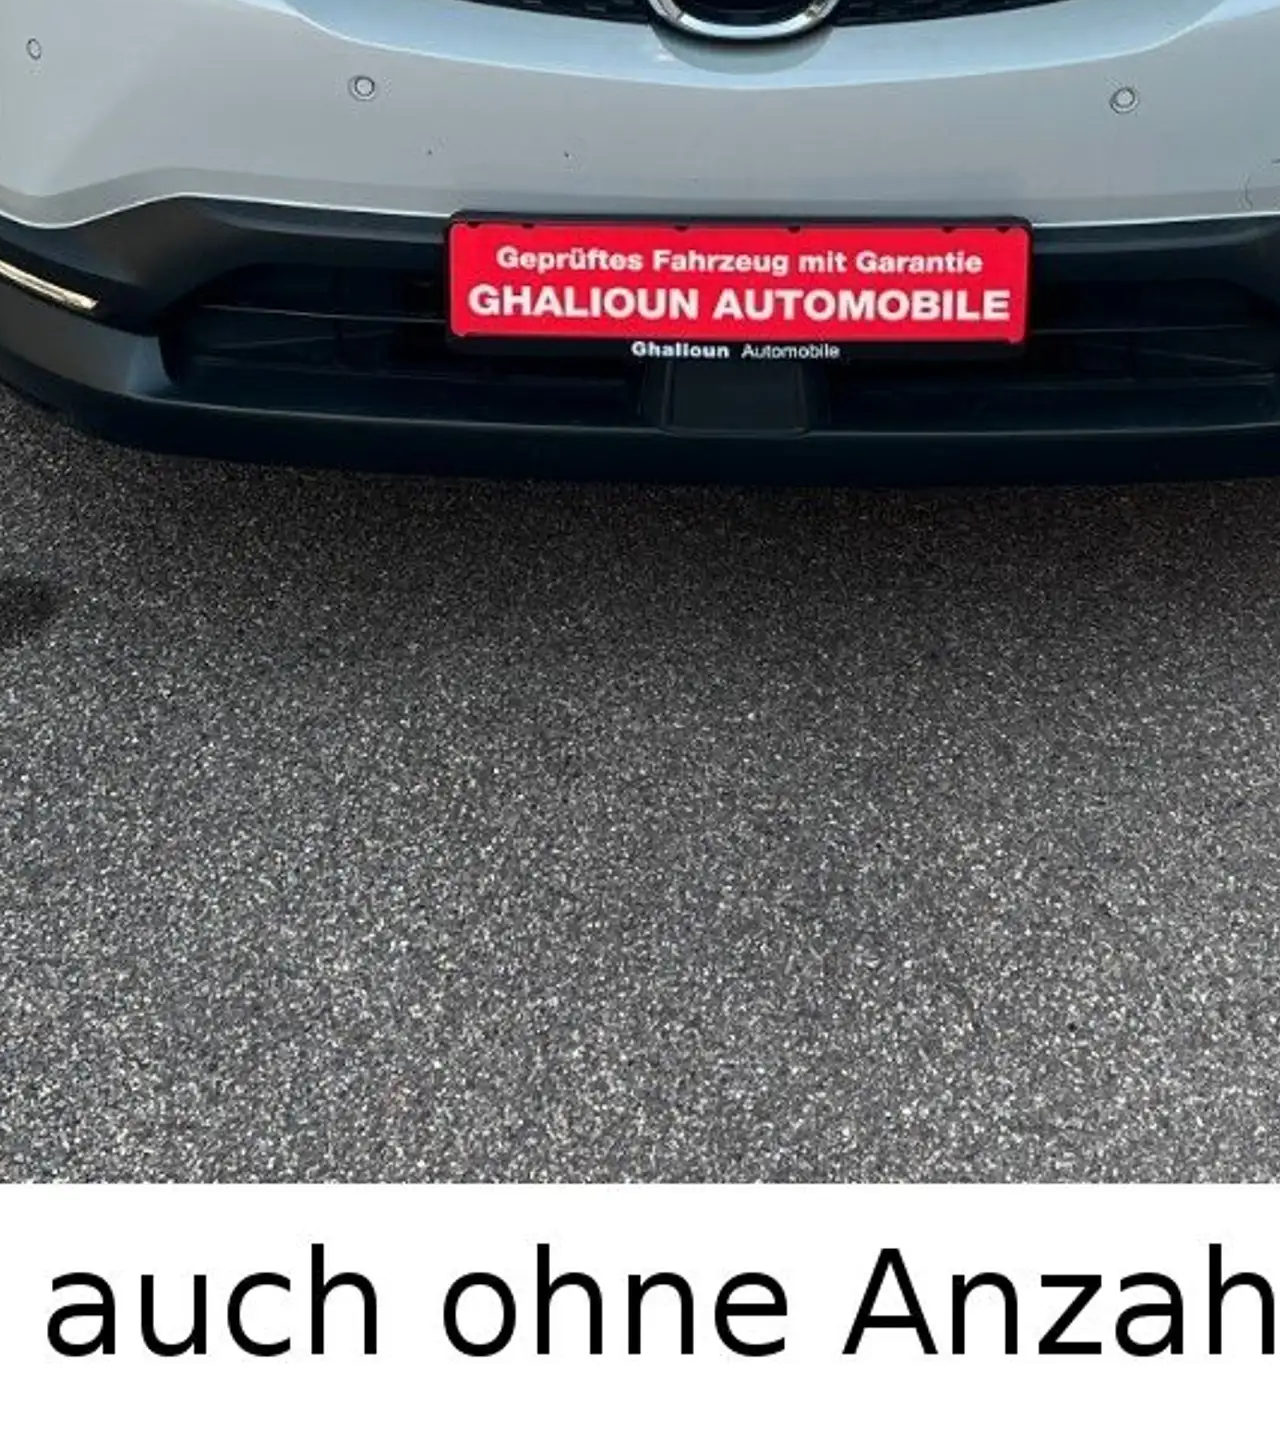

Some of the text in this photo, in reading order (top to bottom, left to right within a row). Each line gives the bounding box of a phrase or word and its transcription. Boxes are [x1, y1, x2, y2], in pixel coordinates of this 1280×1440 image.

[496, 245, 983, 276] Geprüftes Fahrzeug mit Garantie
[468, 282, 1010, 322] GHALIOUN AUTOMOBILE
[630, 340, 840, 359] Ghalioun Automobile
